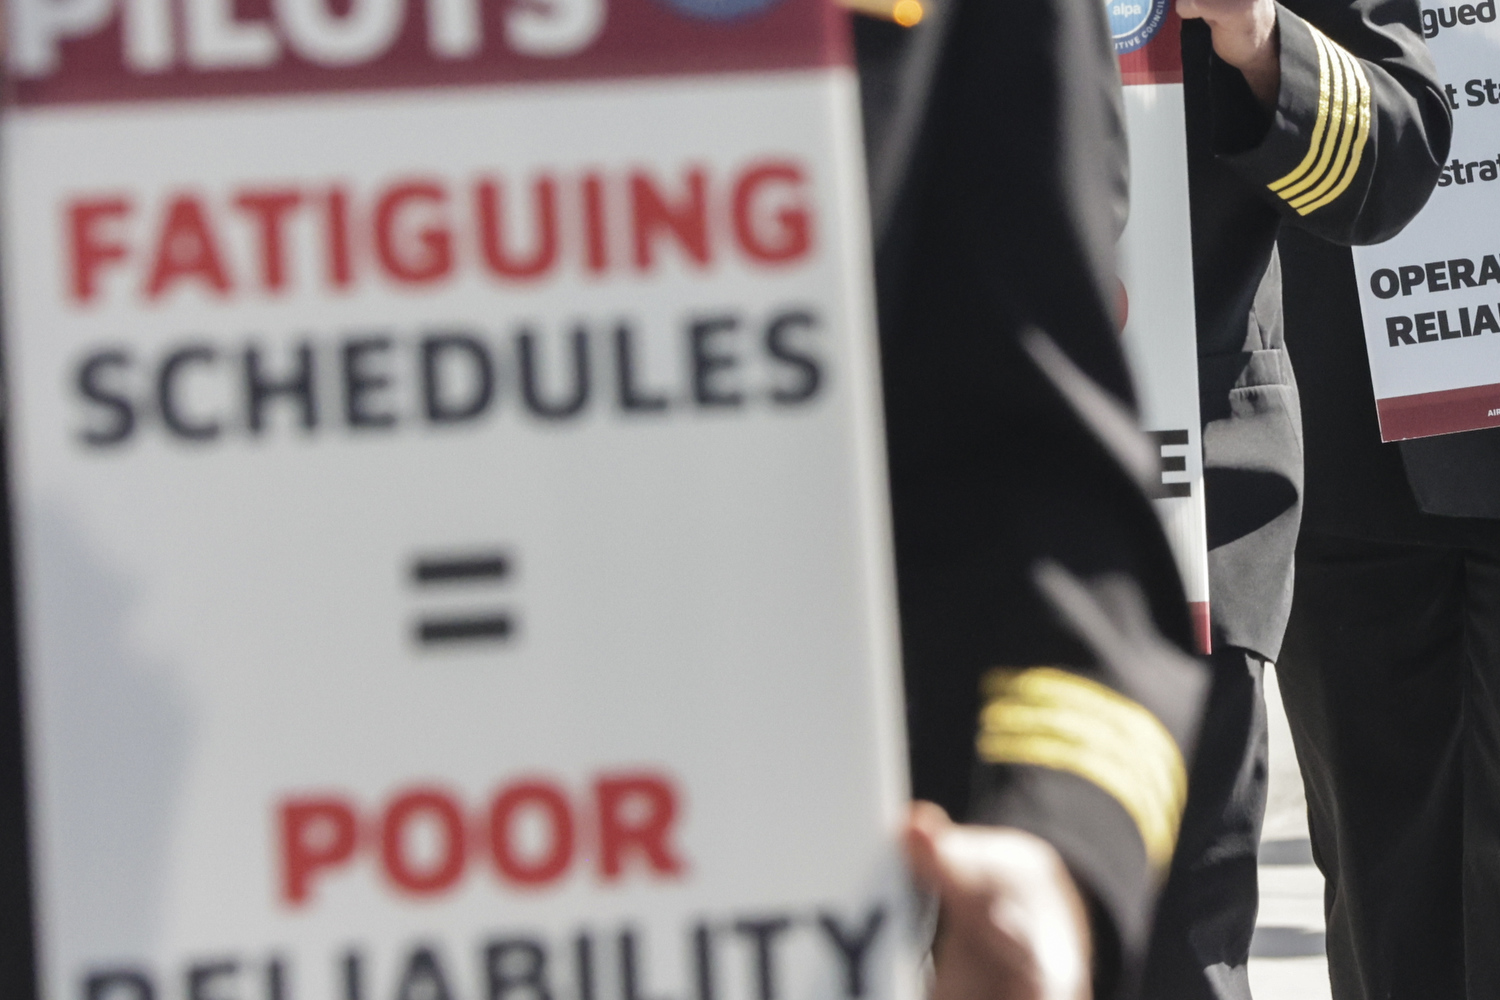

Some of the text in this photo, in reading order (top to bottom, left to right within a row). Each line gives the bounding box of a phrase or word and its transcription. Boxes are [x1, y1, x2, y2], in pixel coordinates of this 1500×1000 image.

[1112, 2, 1142, 18] alpa
[1141, 0, 1165, 38] COUNCIL
[64, 158, 817, 307] FATIGUING
[72, 308, 828, 452] SCHEDULES
[277, 768, 688, 910] POOR
